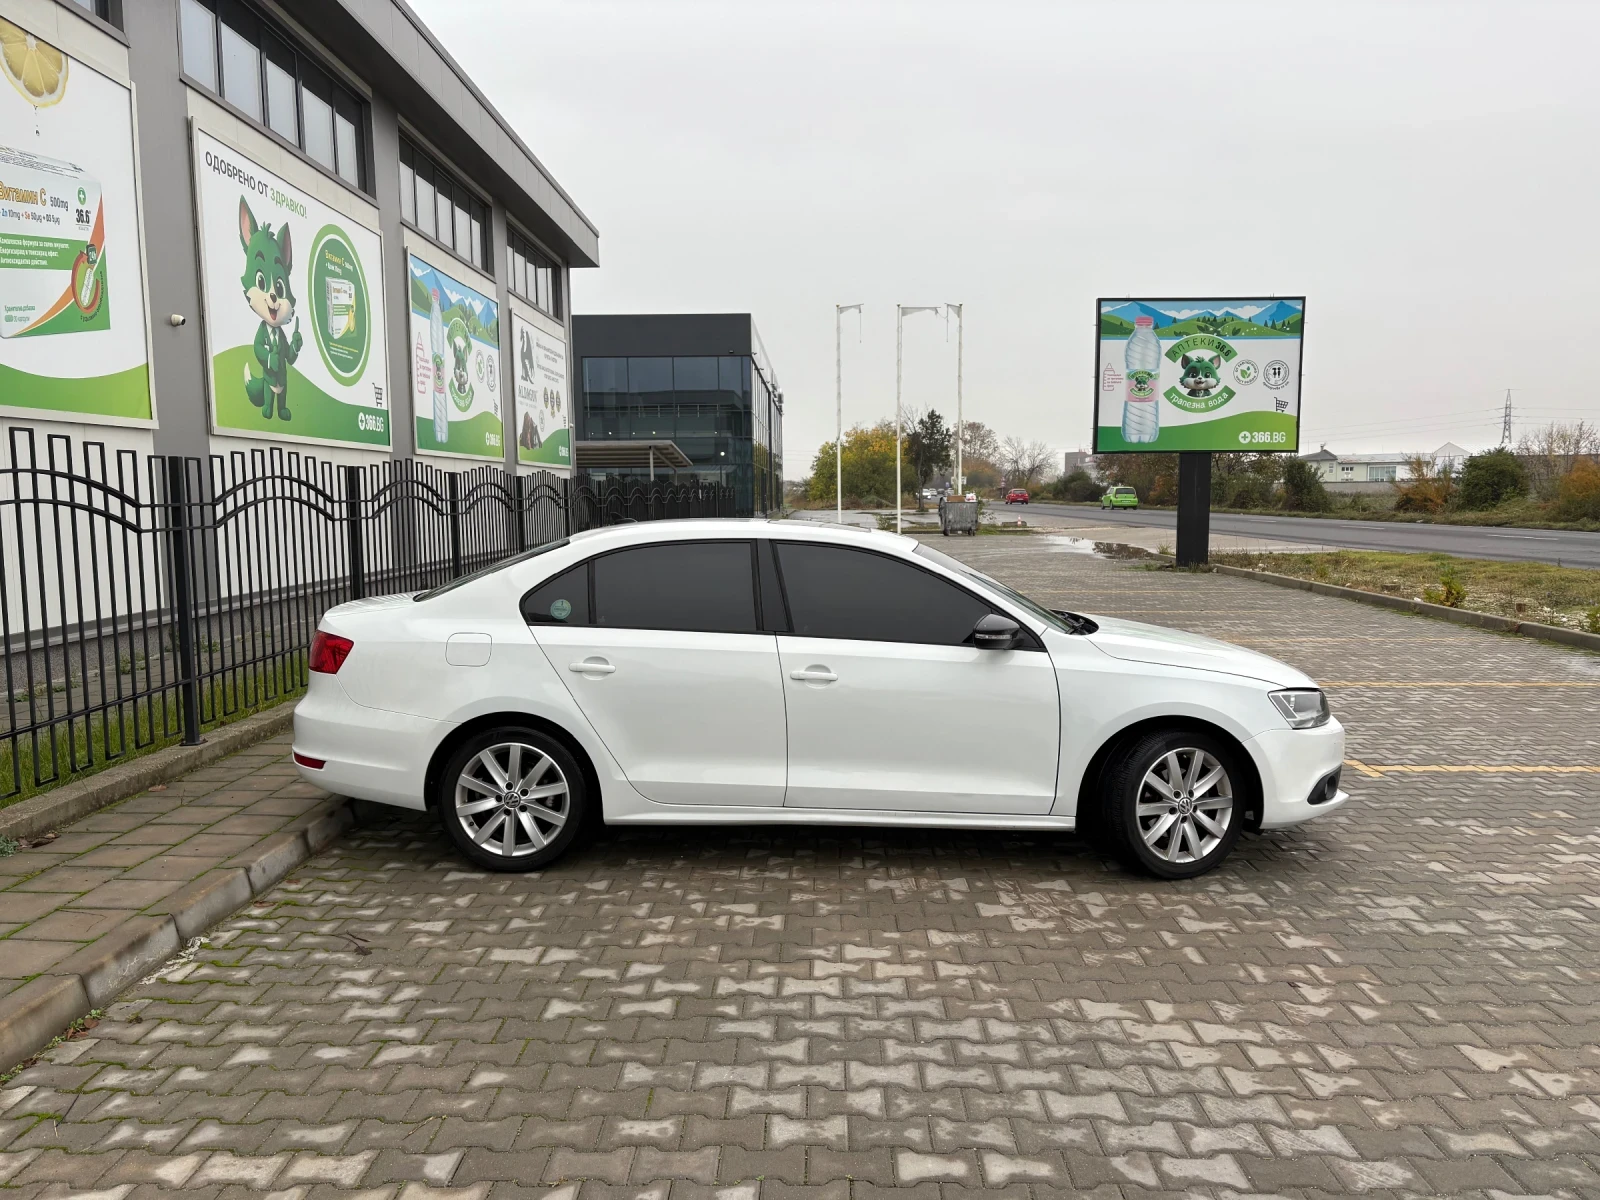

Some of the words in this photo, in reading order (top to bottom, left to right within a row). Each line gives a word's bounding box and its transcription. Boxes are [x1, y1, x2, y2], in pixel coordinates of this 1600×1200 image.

[205, 151, 255, 191] ОДОБРЕНО
[257, 180, 268, 197] ОТ
[270, 187, 308, 219] ЗДРАВКО!
[50, 196, 69, 211] 500mg
[1172, 338, 1215, 358] АПТЕКИ
[1215, 341, 1232, 357] 36.6
[1170, 392, 1206, 409] трапезна
[1208, 392, 1229, 407] вода
[365, 414, 384, 432] 366.BG
[1252, 431, 1286, 443] 366.BG
